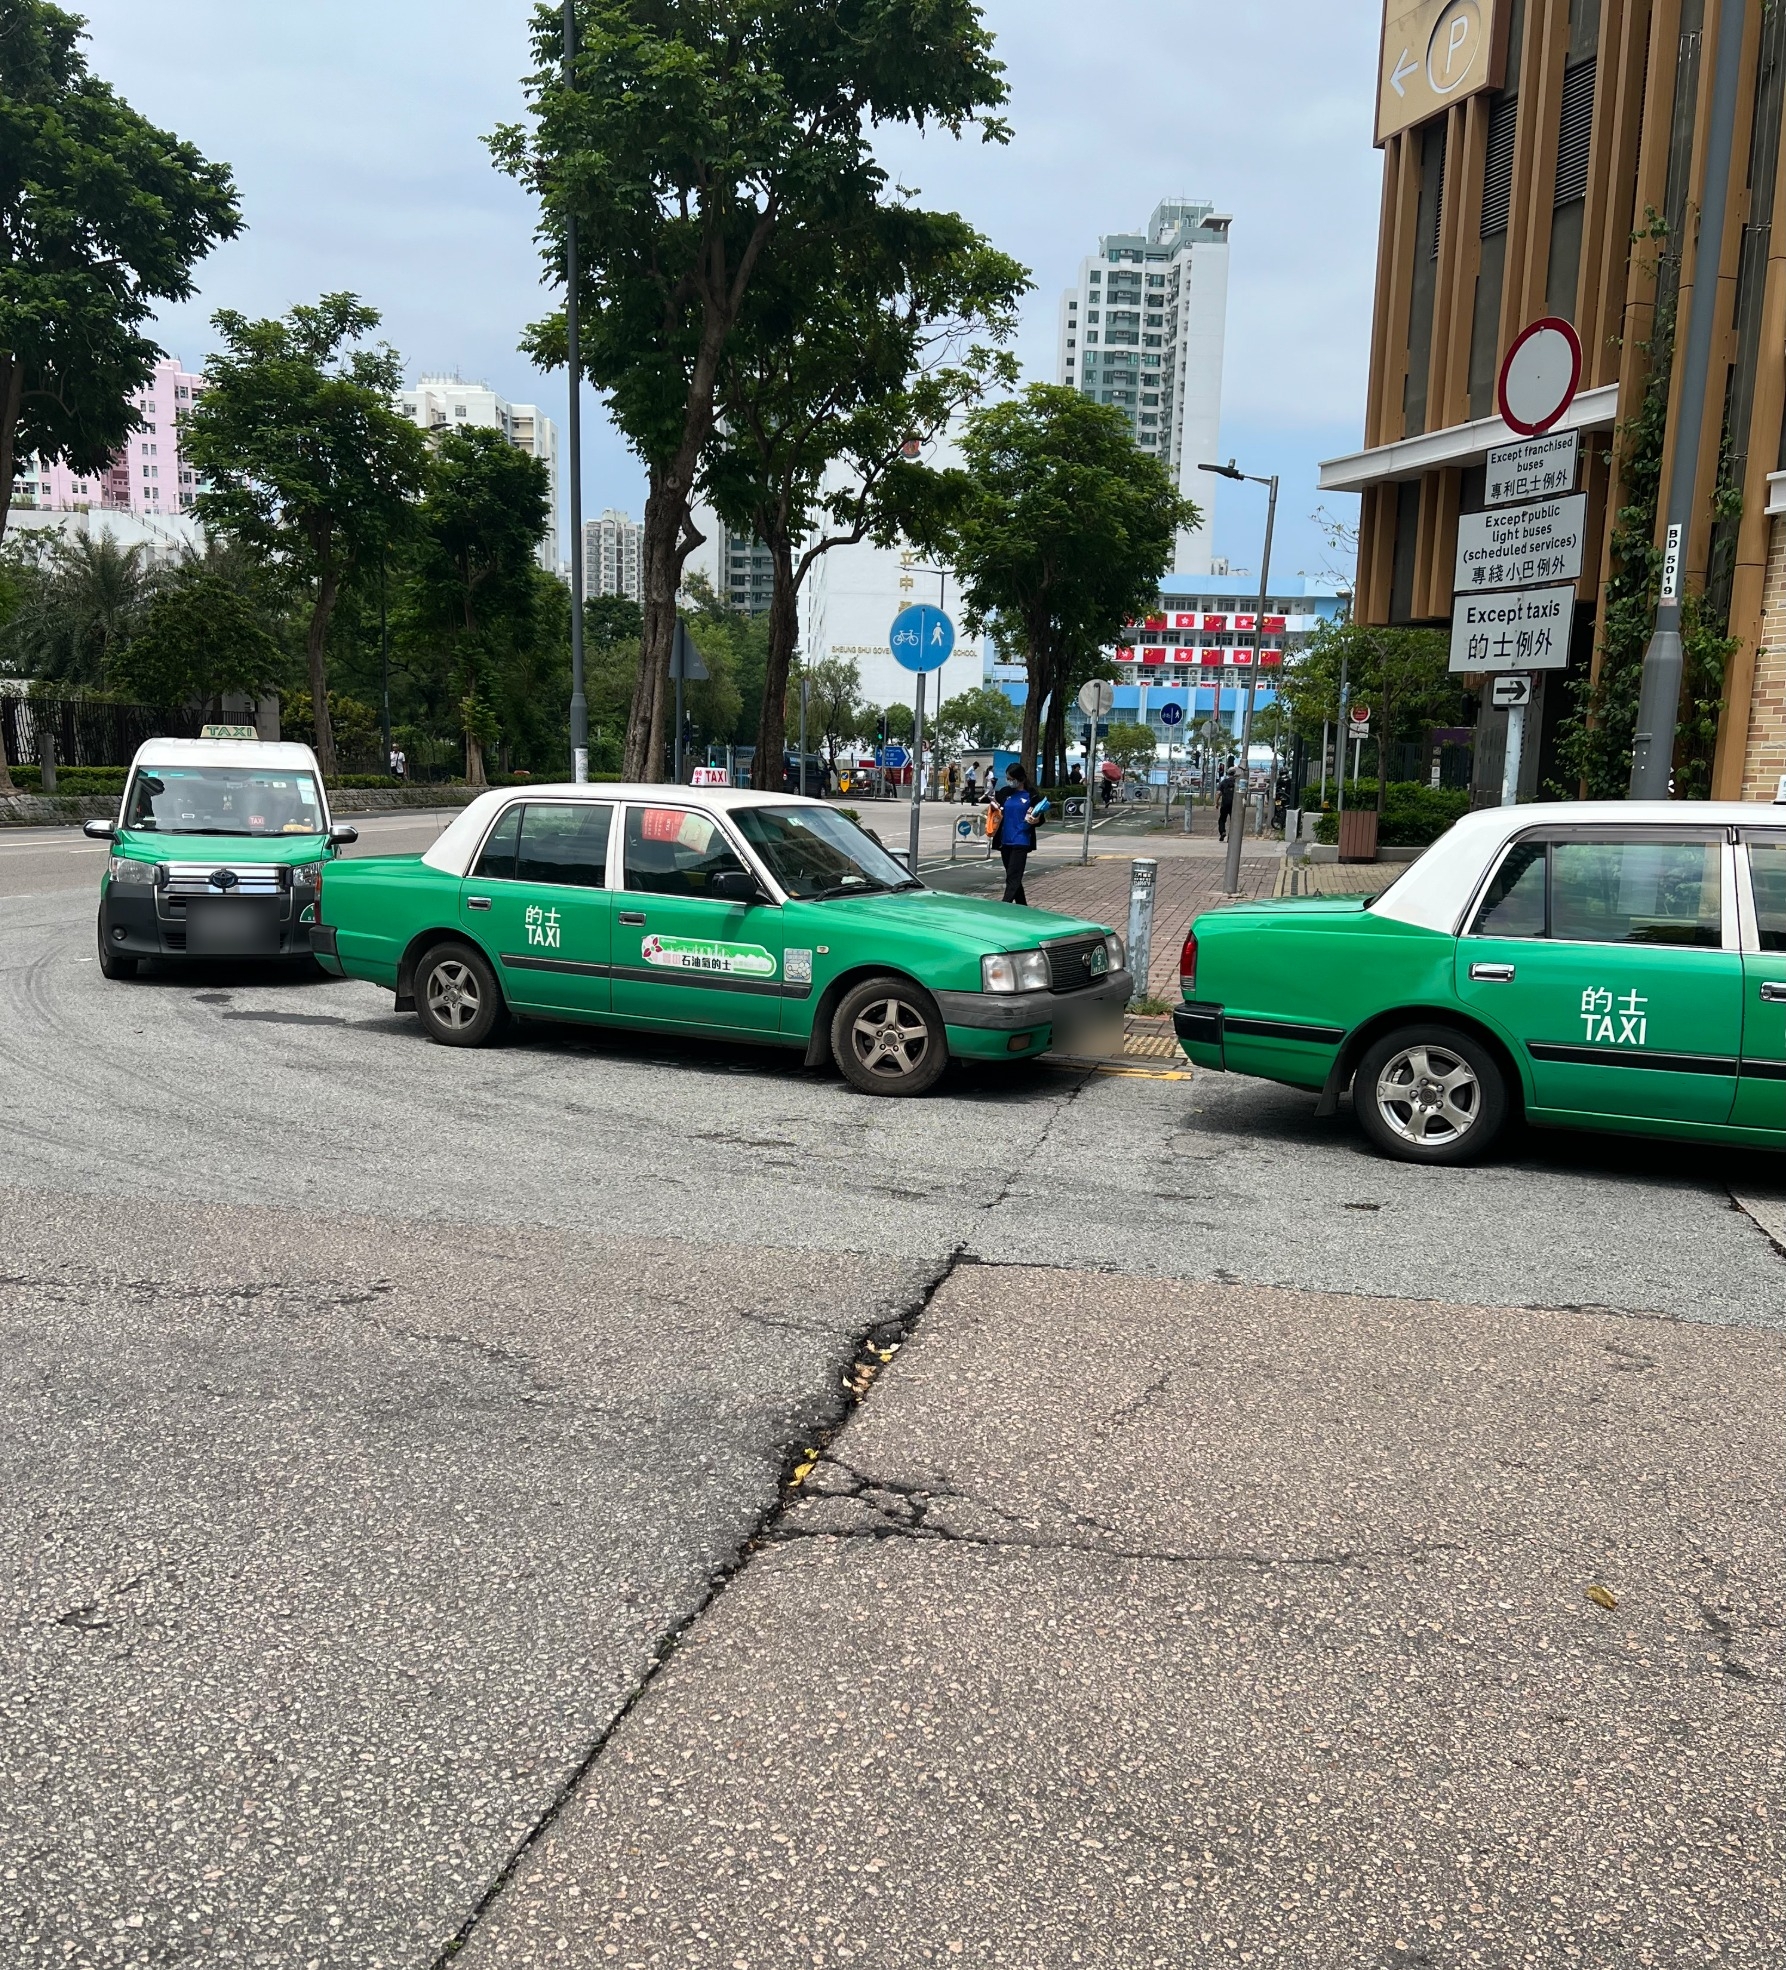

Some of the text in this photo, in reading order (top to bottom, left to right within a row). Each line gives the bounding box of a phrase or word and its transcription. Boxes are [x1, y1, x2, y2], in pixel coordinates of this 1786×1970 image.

[1445, 14, 1468, 74] P
[1491, 436, 1573, 464] Except franchised
[1516, 459, 1544, 473] buses
[1490, 469, 1568, 500] 專利巴士例外
[1485, 505, 1561, 528] Except public
[1492, 524, 1552, 545] light buses
[1463, 533, 1577, 564] (scheduled services)
[1663, 529, 1678, 595] BD 5019
[1466, 599, 1561, 625] Except taxis
[831, 645, 978, 658] SHEUNG SHUI GOVE SCHOOL
[1467, 627, 1553, 660] 的士例外
[206, 725, 252, 737] TAXI
[705, 770, 727, 783] TAXI
[250, 817, 264, 825] TAXI
[525, 904, 561, 927] 的士
[525, 924, 560, 948] TAXI
[1581, 985, 1649, 1016] 的士
[1580, 1013, 1647, 1045] TAXI
